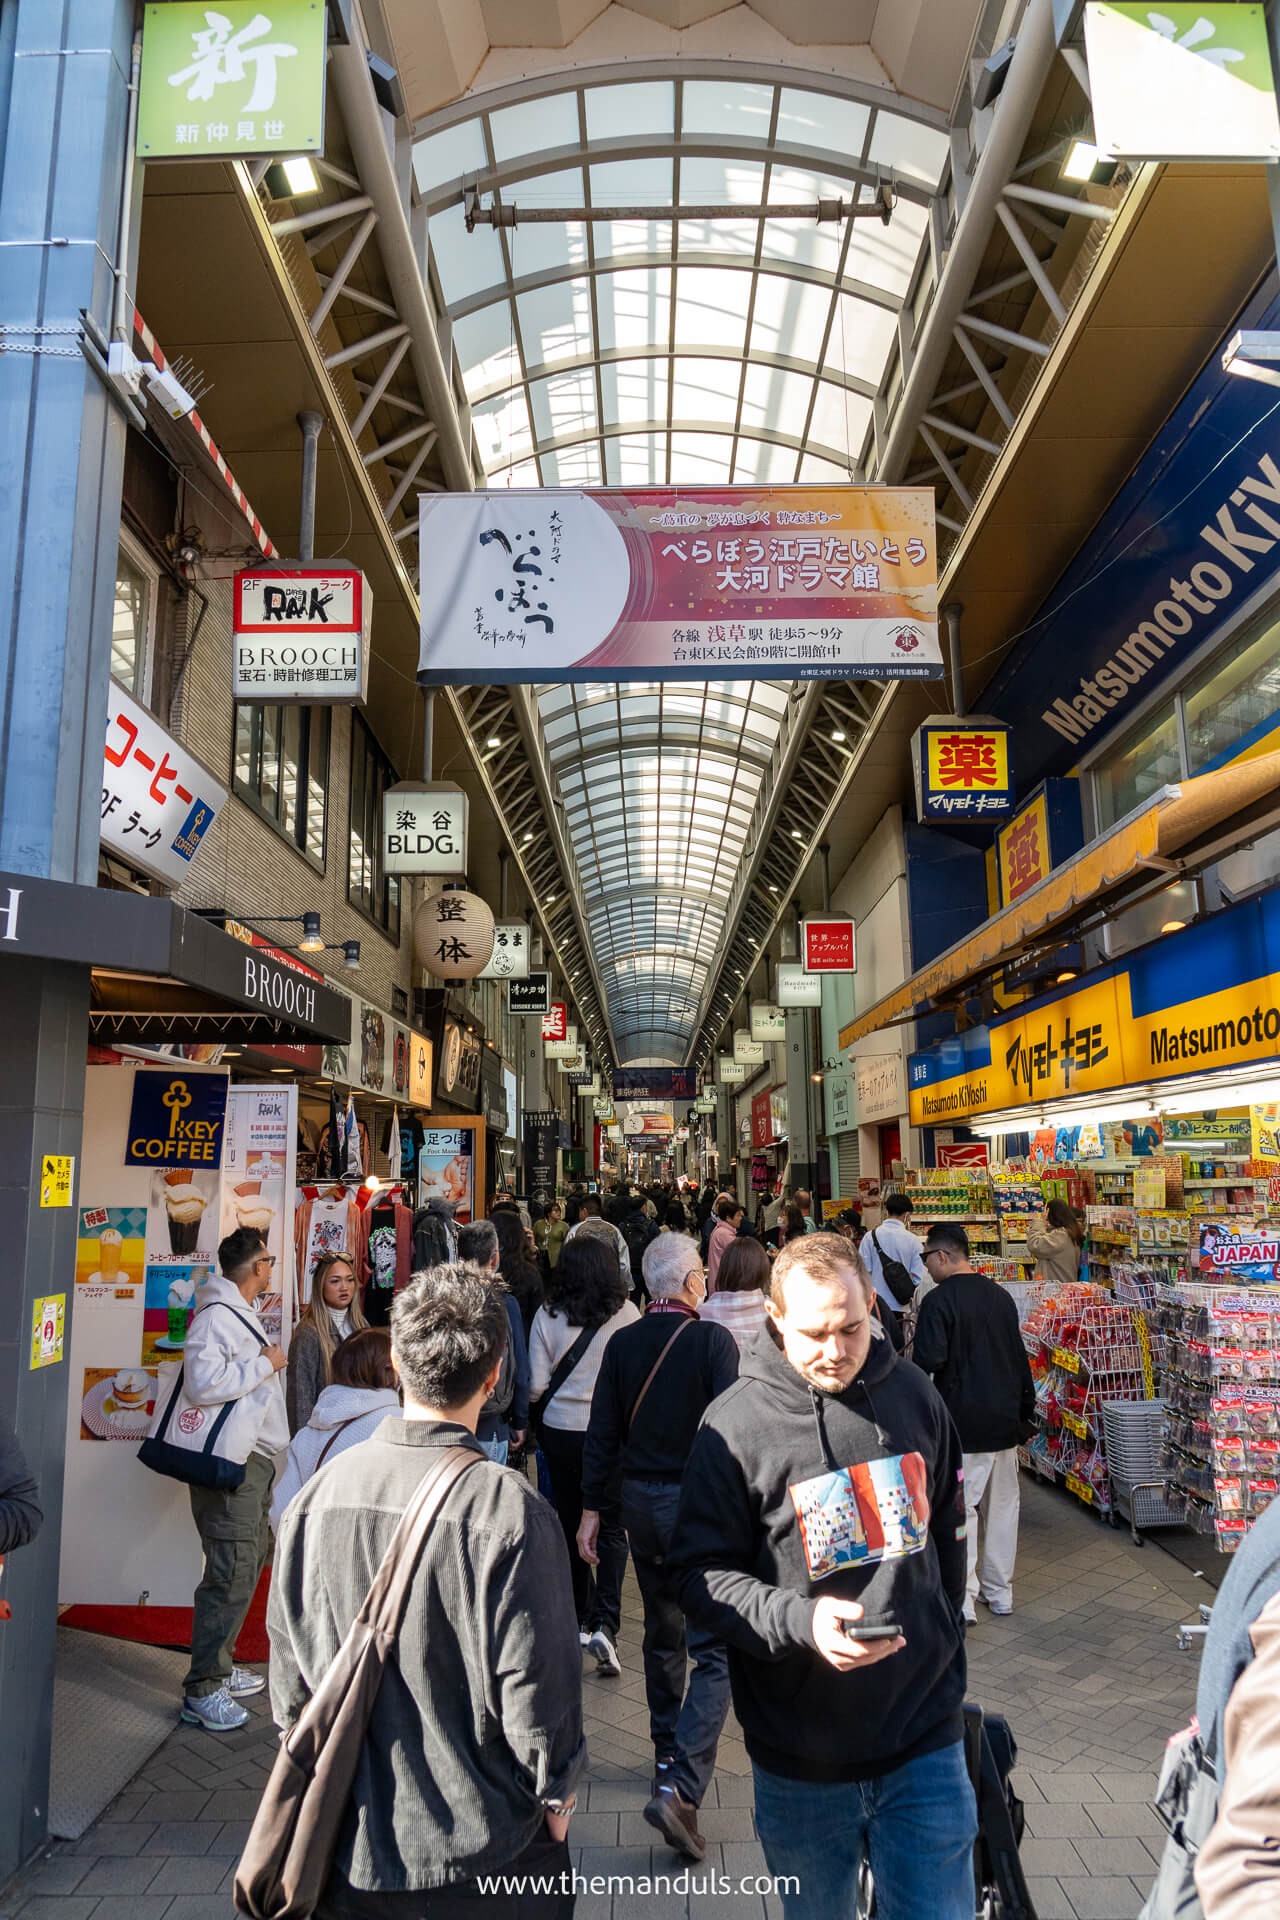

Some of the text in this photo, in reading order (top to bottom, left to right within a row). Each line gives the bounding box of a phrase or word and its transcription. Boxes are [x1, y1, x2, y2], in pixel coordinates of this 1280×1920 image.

[168, 11, 298, 112] 新
[176, 120, 285, 143] 新仲見世
[661, 537, 928, 565] べらぼう江戸たいとう
[243, 580, 261, 590] 2F
[320, 580, 352, 591] ラーク
[715, 564, 881, 592] 大河ドラマ館
[671, 629, 701, 643] 各線
[707, 624, 764, 643] 浅草駅
[239, 648, 357, 665] BROOCH
[673, 645, 841, 660] 台東区民会館9階に開館中
[1041, 561, 1232, 744] Matsumoto
[938, 735, 998, 786] 薬
[928, 794, 1010, 813] マツモトキヨシ
[121, 811, 162, 849] ラーク
[396, 810, 452, 831] 染谷
[174, 834, 195, 857] COFFEE
[388, 835, 460, 854] BLDG.
[434, 897, 473, 965] 整体
[496, 932, 523, 947] るま
[245, 956, 315, 1023] BROOCH
[1151, 1006, 1280, 1065] Matsumoto
[530, 1050, 536, 1058] 8
[793, 1044, 799, 1052] 8
[1005, 1017, 1109, 1096] マツモトキヨシ
[922, 1091, 958, 1116] Matsumoto
[958, 1080, 988, 1110] KiYoshi
[176, 1120, 221, 1140] KEY
[427, 1133, 466, 1146] 足つぼ
[1193, 1124, 1240, 1134] ビタミン剤
[131, 1139, 216, 1160] COFFEE
[1214, 1244, 1277, 1263] JAPAN
